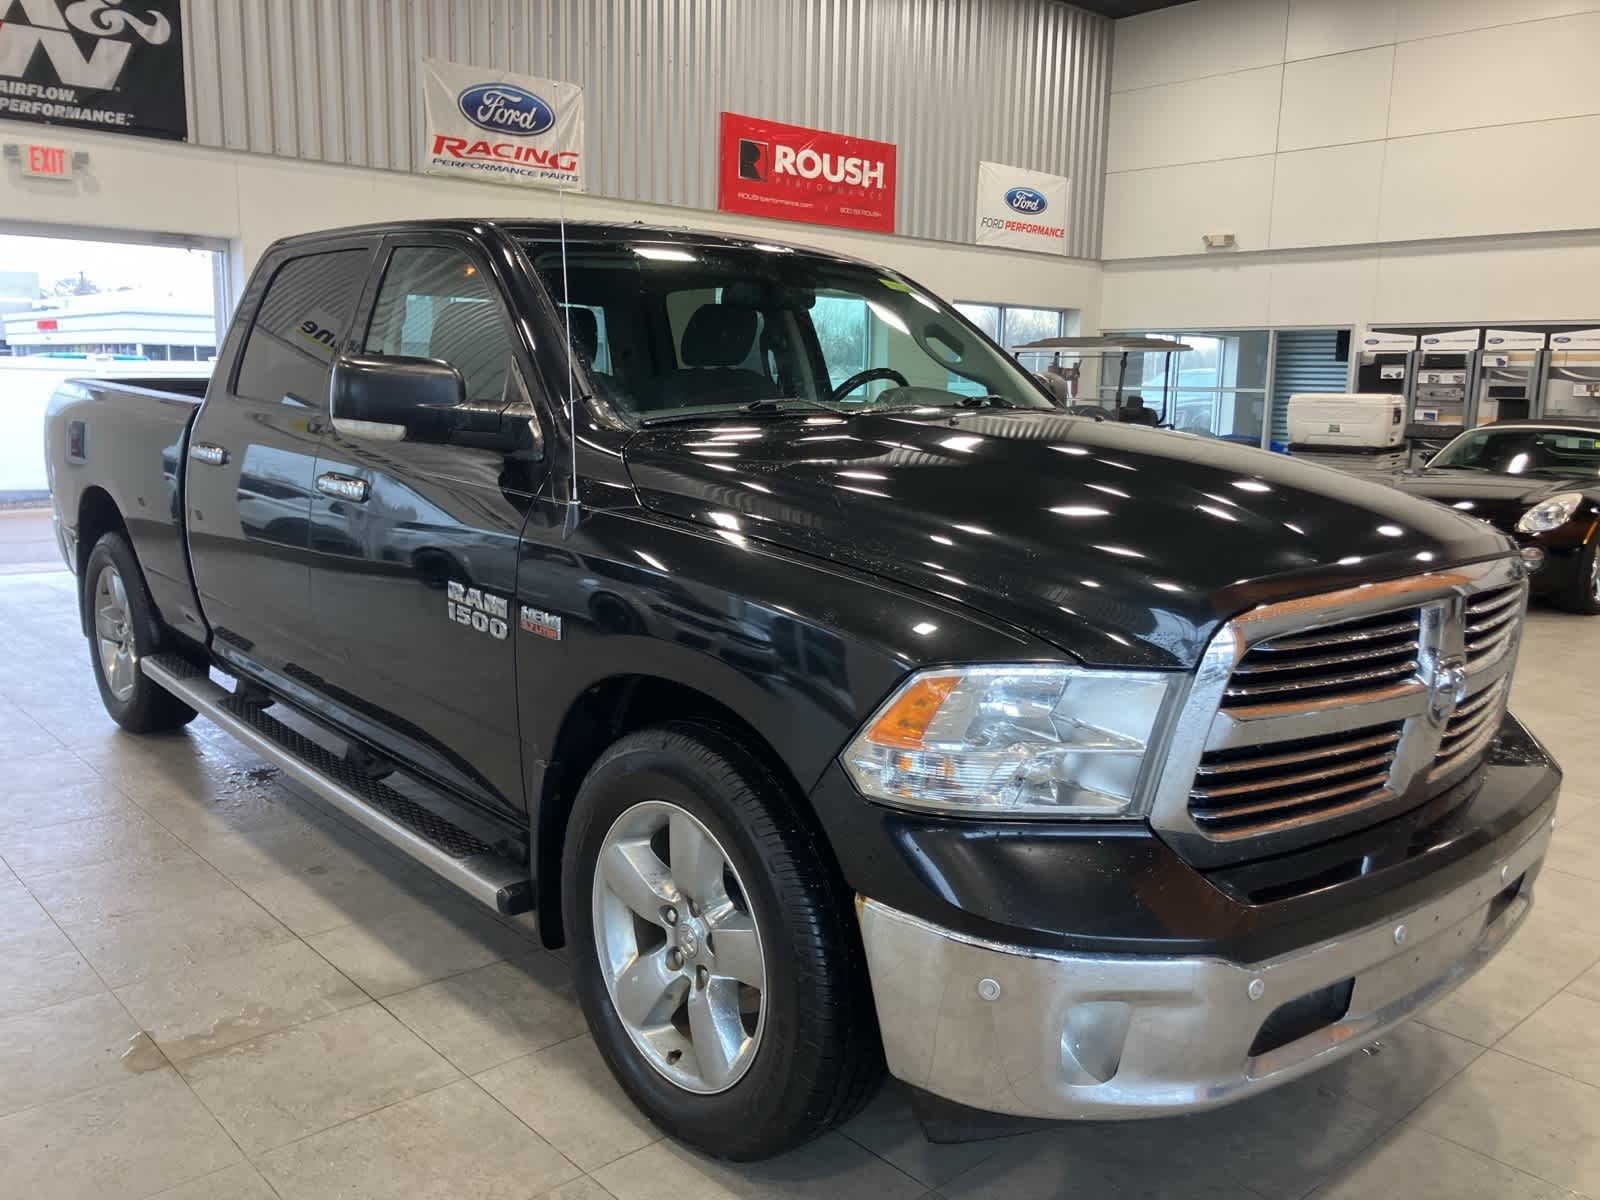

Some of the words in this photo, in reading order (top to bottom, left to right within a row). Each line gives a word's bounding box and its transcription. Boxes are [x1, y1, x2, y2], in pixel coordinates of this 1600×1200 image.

[477, 90, 537, 130] Ford
[28, 145, 65, 174] EXIT
[432, 134, 579, 171] RACING
[432, 158, 538, 177] PERFORMANCE
[540, 171, 579, 182] PARTS
[774, 144, 885, 189] ROUSH
[1012, 190, 1040, 211] Ford
[980, 216, 1004, 230] FORD
[1004, 220, 1065, 238] PERFORMANCE
[447, 580, 508, 620] RAM
[447, 600, 509, 640] 1500
